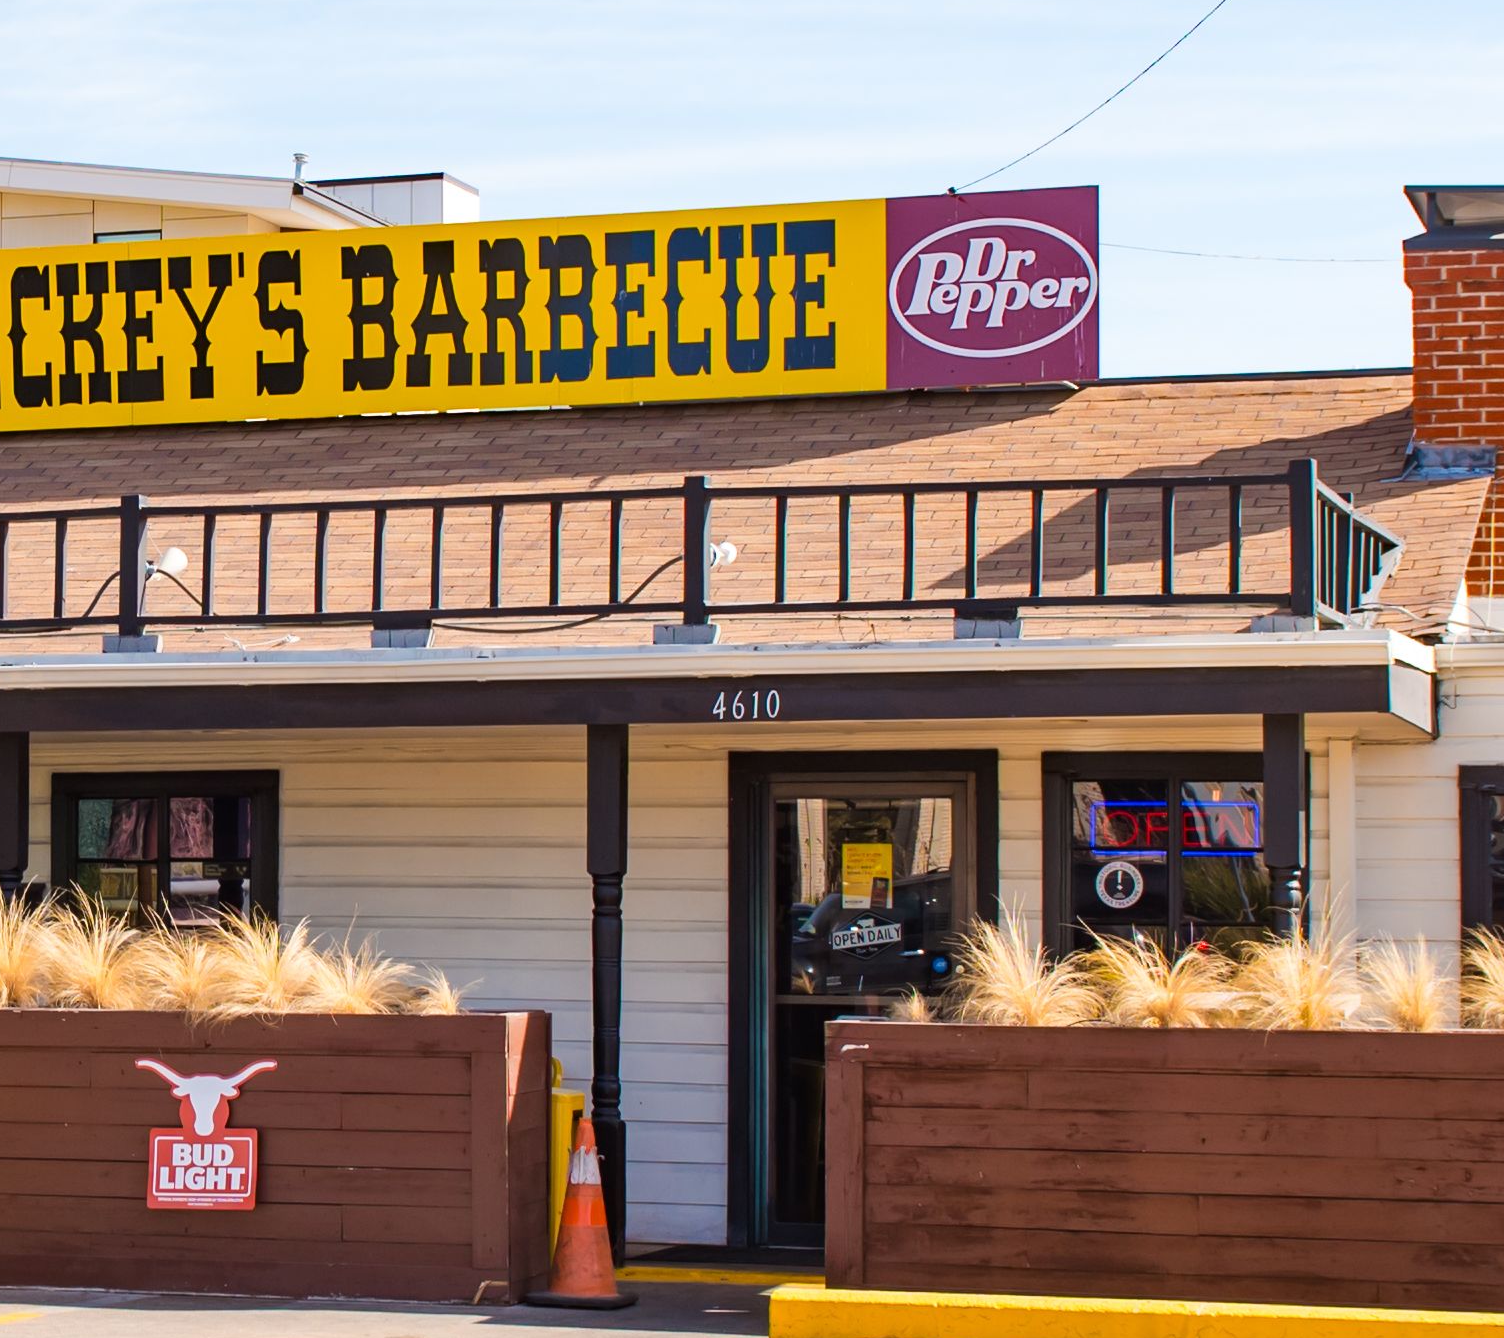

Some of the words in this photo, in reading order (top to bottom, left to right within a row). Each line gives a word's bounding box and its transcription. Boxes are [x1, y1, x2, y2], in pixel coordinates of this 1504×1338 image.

[959, 237, 1036, 283] Dr
[340, 219, 836, 392] BARBECUE
[904, 252, 1089, 329] Pepper
[712, 690, 780, 720] 4610
[1103, 810, 1252, 847] OPEN
[833, 929, 865, 947] OPEN
[867, 925, 902, 943] DAILY
[172, 1143, 235, 1167] BUD
